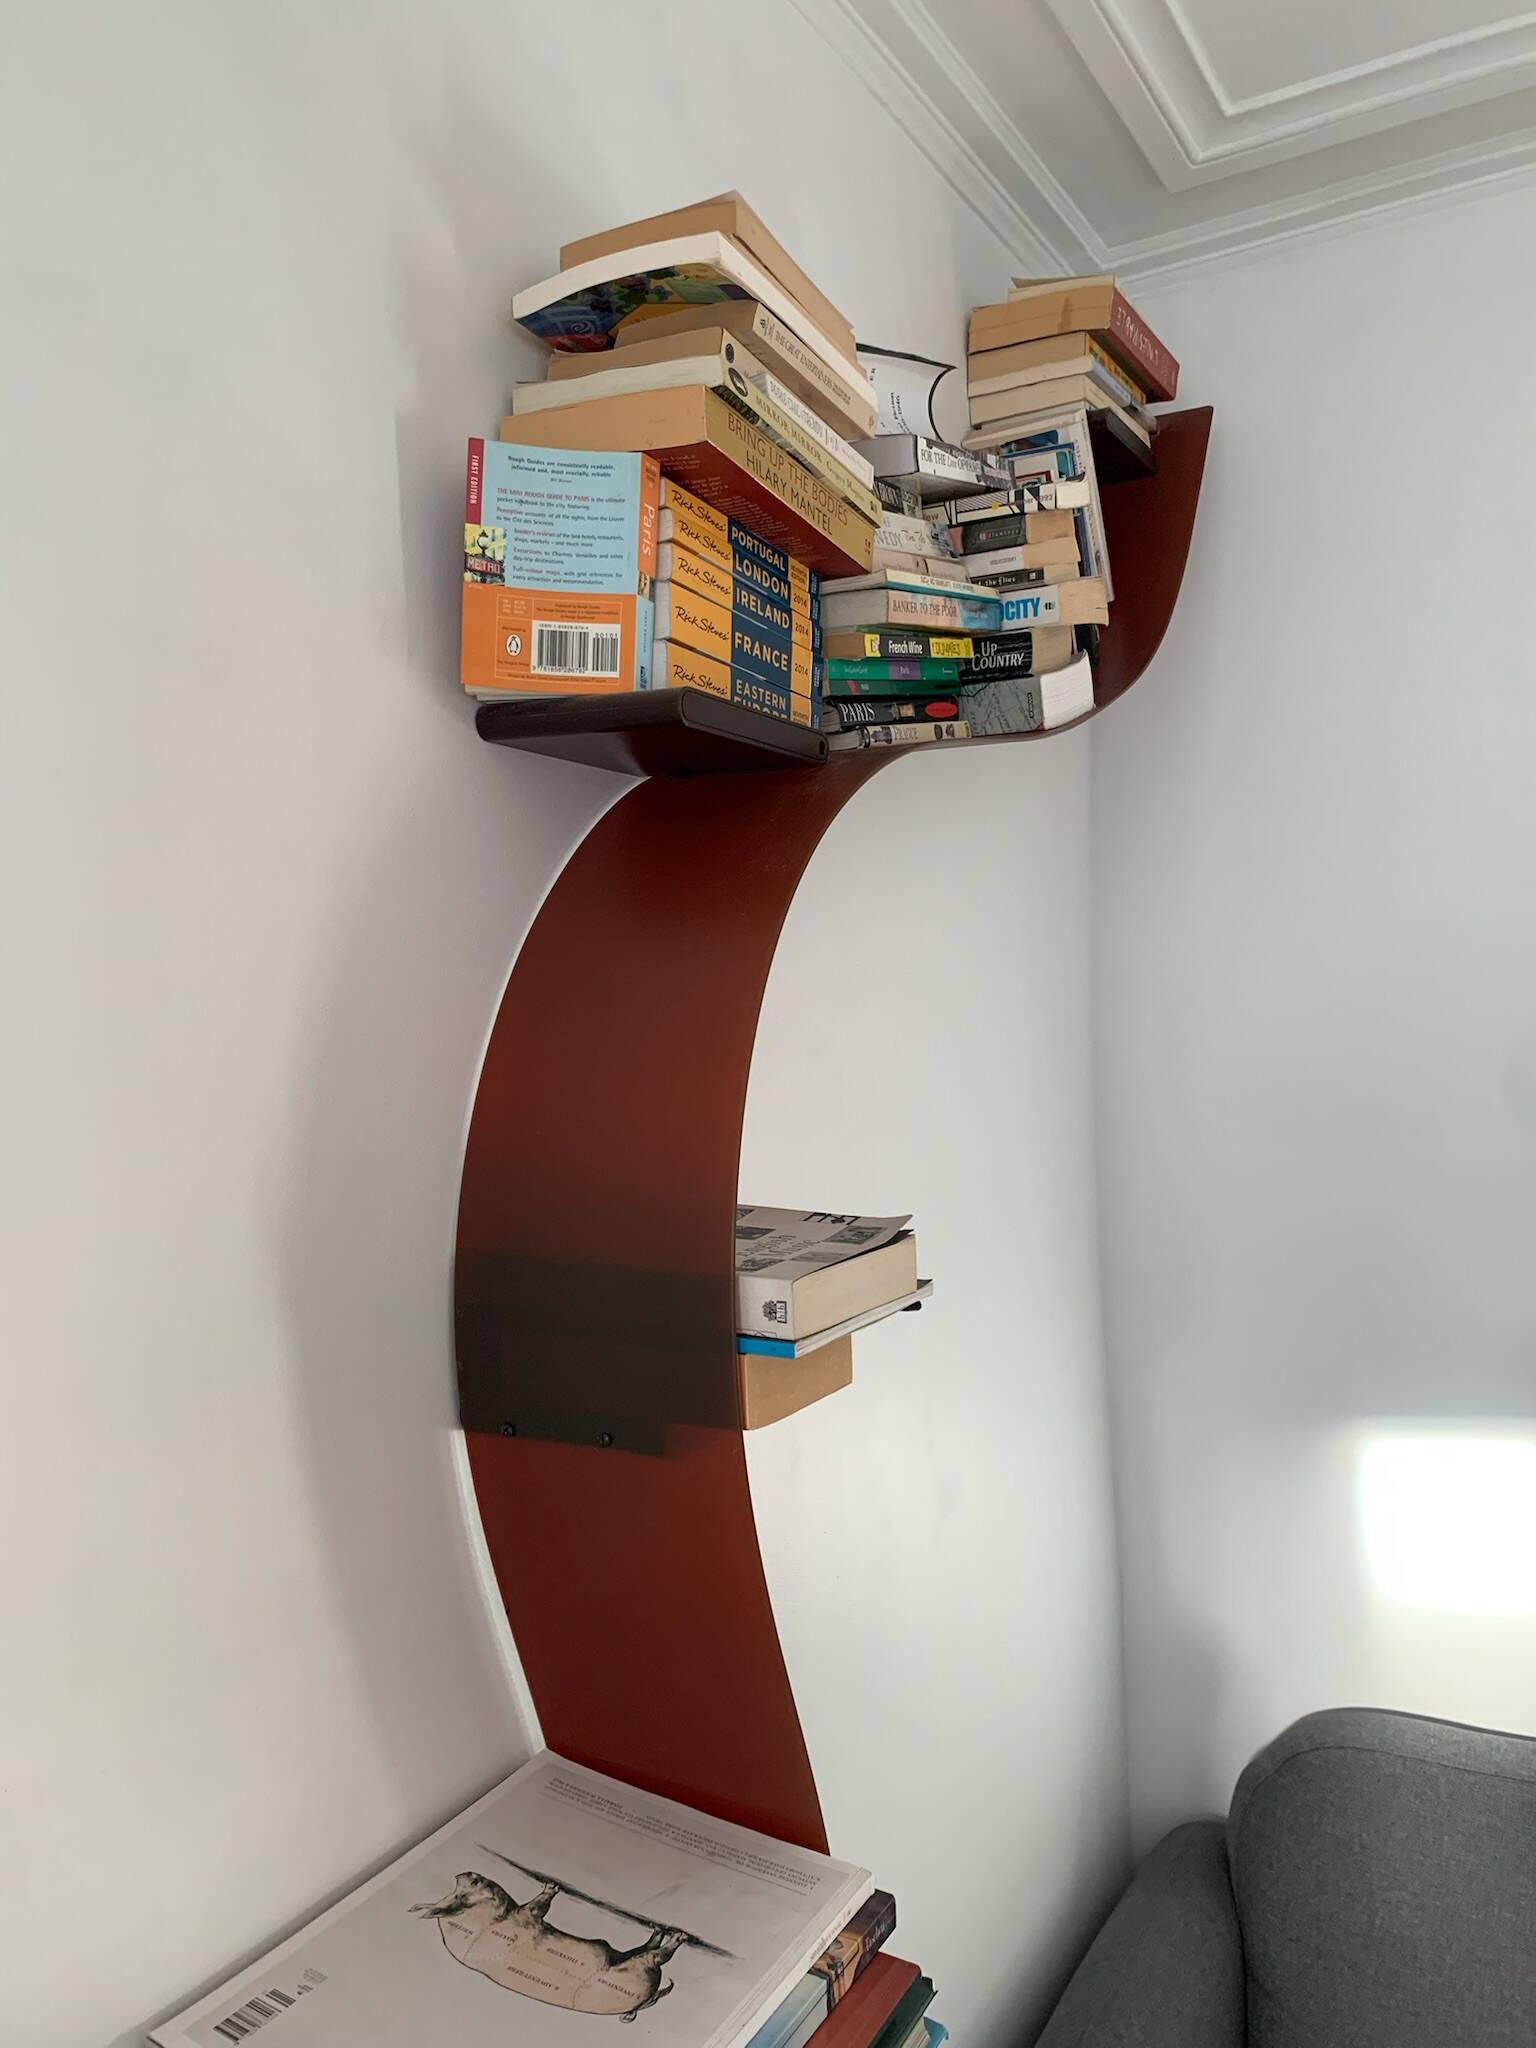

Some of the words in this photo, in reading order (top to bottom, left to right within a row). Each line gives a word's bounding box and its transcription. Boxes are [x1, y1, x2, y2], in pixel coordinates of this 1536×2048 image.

[472, 454, 480, 475] FIRST
[728, 412, 766, 458] BRING
[770, 446, 785, 471] UP
[787, 461, 809, 492] THE
[811, 482, 850, 526] BODIES
[470, 476, 478, 504] EDITION
[746, 450, 787, 497] HILARY
[791, 487, 833, 536] MANTEL
[672, 489, 698, 513] Rick
[694, 507, 726, 533] Steves'
[642, 503, 656, 556] Paris
[678, 520, 701, 543] Rick
[698, 536, 731, 562] Steves'
[731, 526, 786, 572] PORTUGAL
[678, 557, 700, 580] Rick
[698, 567, 731, 595] Steves'
[736, 553, 789, 600] LONDON
[736, 587, 790, 630] IRELAND
[793, 594, 808, 609] 2014
[892, 601, 918, 614] BANKER
[920, 602, 928, 614] TO
[929, 603, 940, 616] THE
[675, 606, 700, 628] Rick
[697, 617, 729, 641] Steves'
[794, 622, 809, 636] 2014
[735, 632, 788, 672] FRANCE
[888, 640, 908, 654] French
[907, 641, 923, 654] Wine
[972, 652, 1024, 671] COUNTRY
[981, 642, 998, 656] UP
[673, 664, 696, 684] Rick
[695, 674, 728, 696] Steves'
[794, 663, 808, 676] 2014
[736, 680, 786, 711] EASTERN
[840, 702, 876, 722] PARIS
